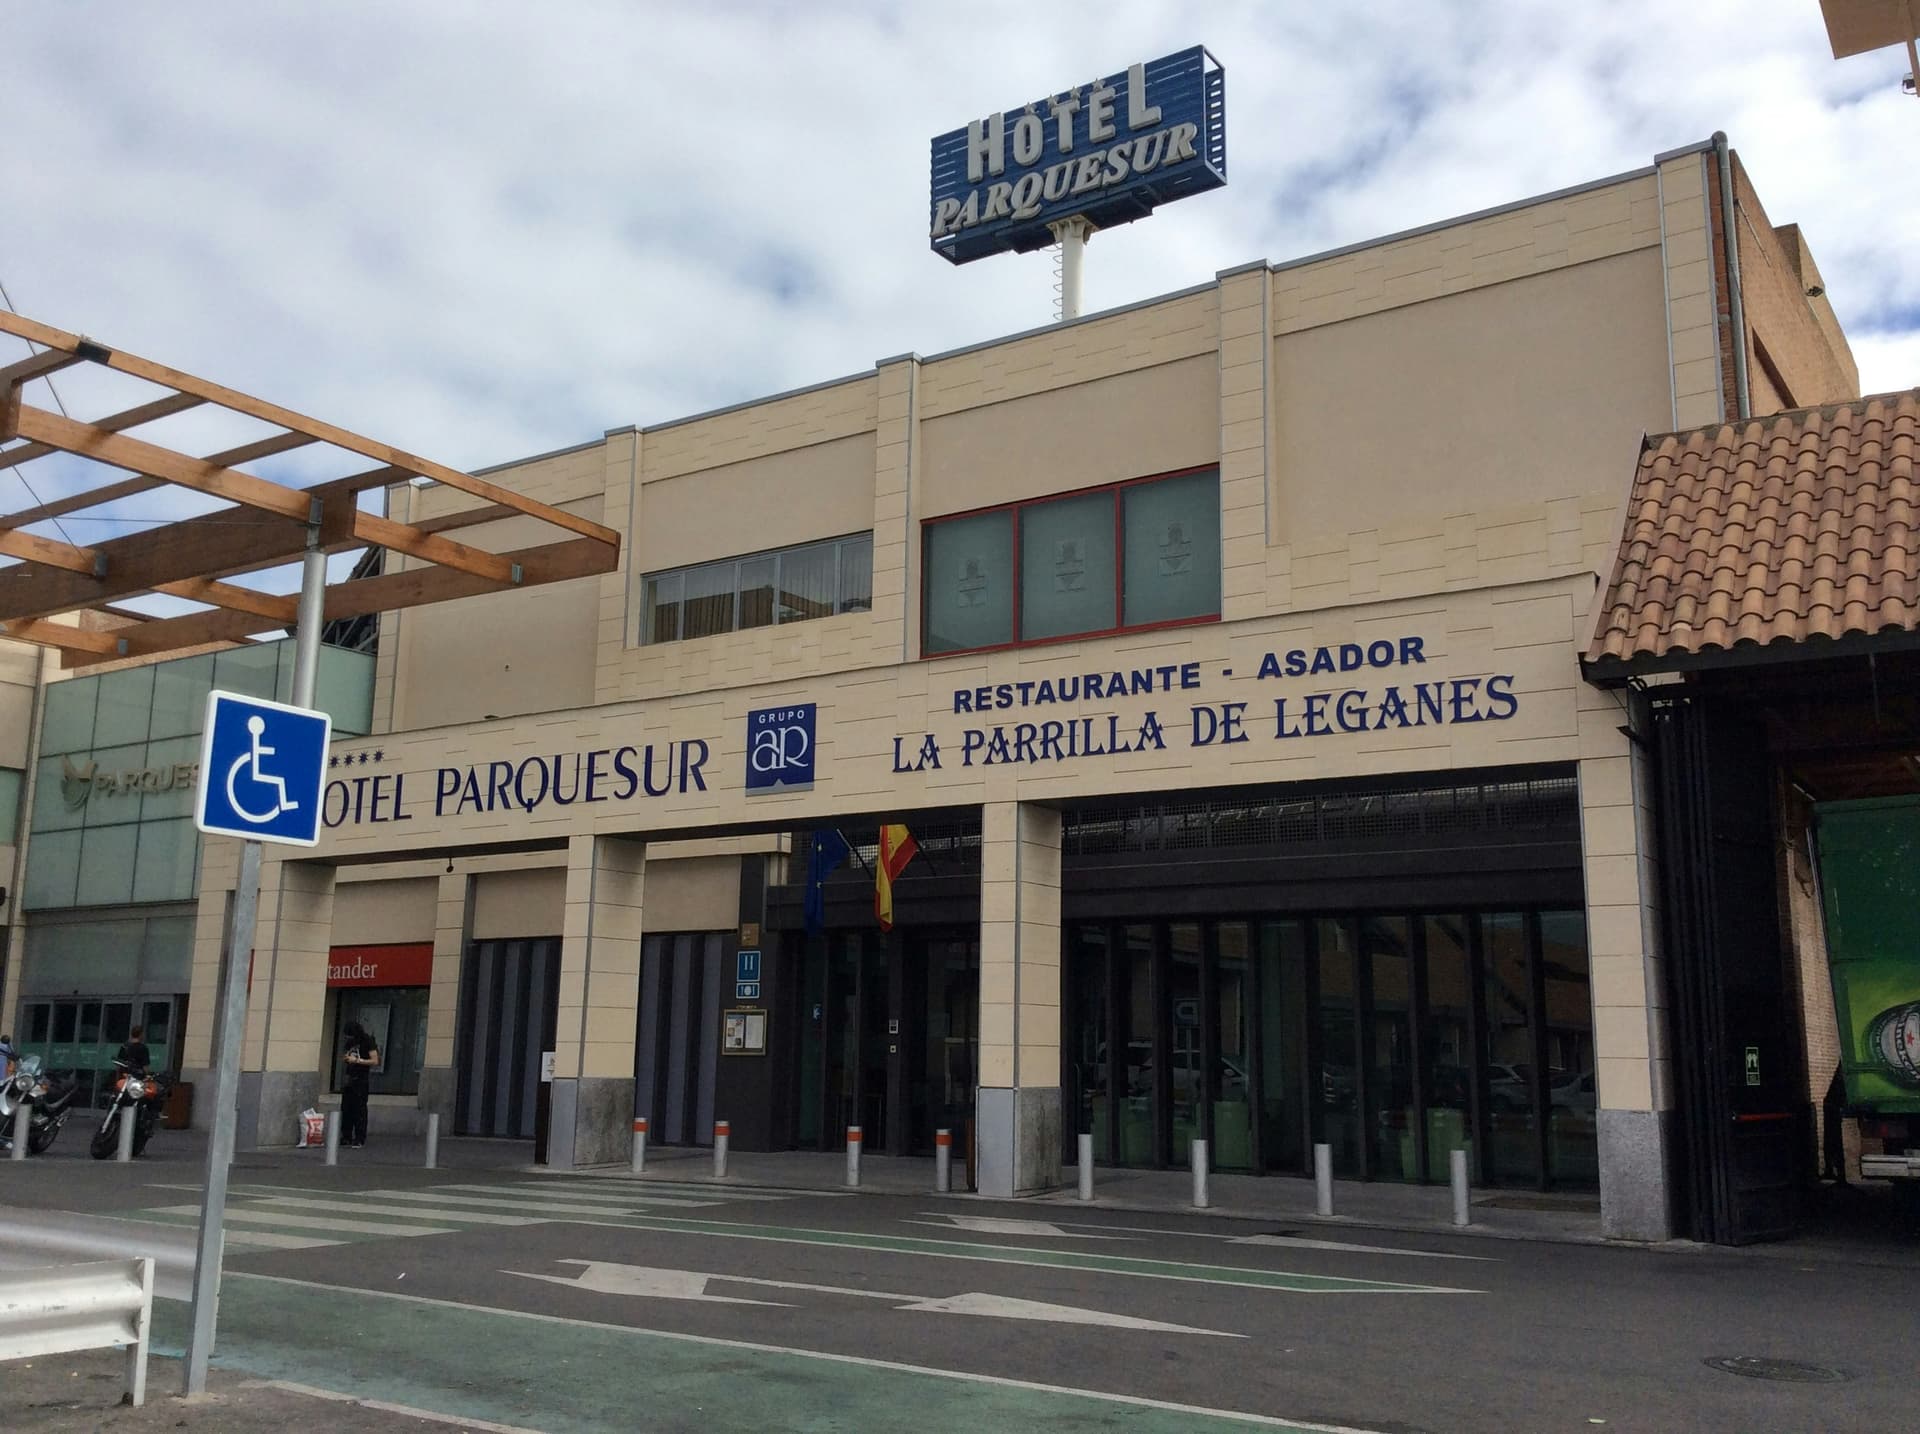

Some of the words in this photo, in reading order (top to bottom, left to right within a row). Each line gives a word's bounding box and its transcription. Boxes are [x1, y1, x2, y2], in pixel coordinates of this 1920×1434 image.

[967, 62, 1162, 183] HOTEL
[929, 122, 1198, 237] PARQUESUR
[758, 709, 805, 724] GRUPO
[954, 662, 1201, 713] RESTAURANTE
[1257, 636, 1426, 680] ASADOR
[892, 733, 943, 773] LA
[962, 710, 1167, 766] PARRILLA
[1191, 702, 1249, 747] DE
[1273, 675, 1519, 739] LEGANES
[321, 773, 413, 828] OTEL
[434, 739, 709, 816] PARQUESUR
[327, 956, 378, 979] tander
